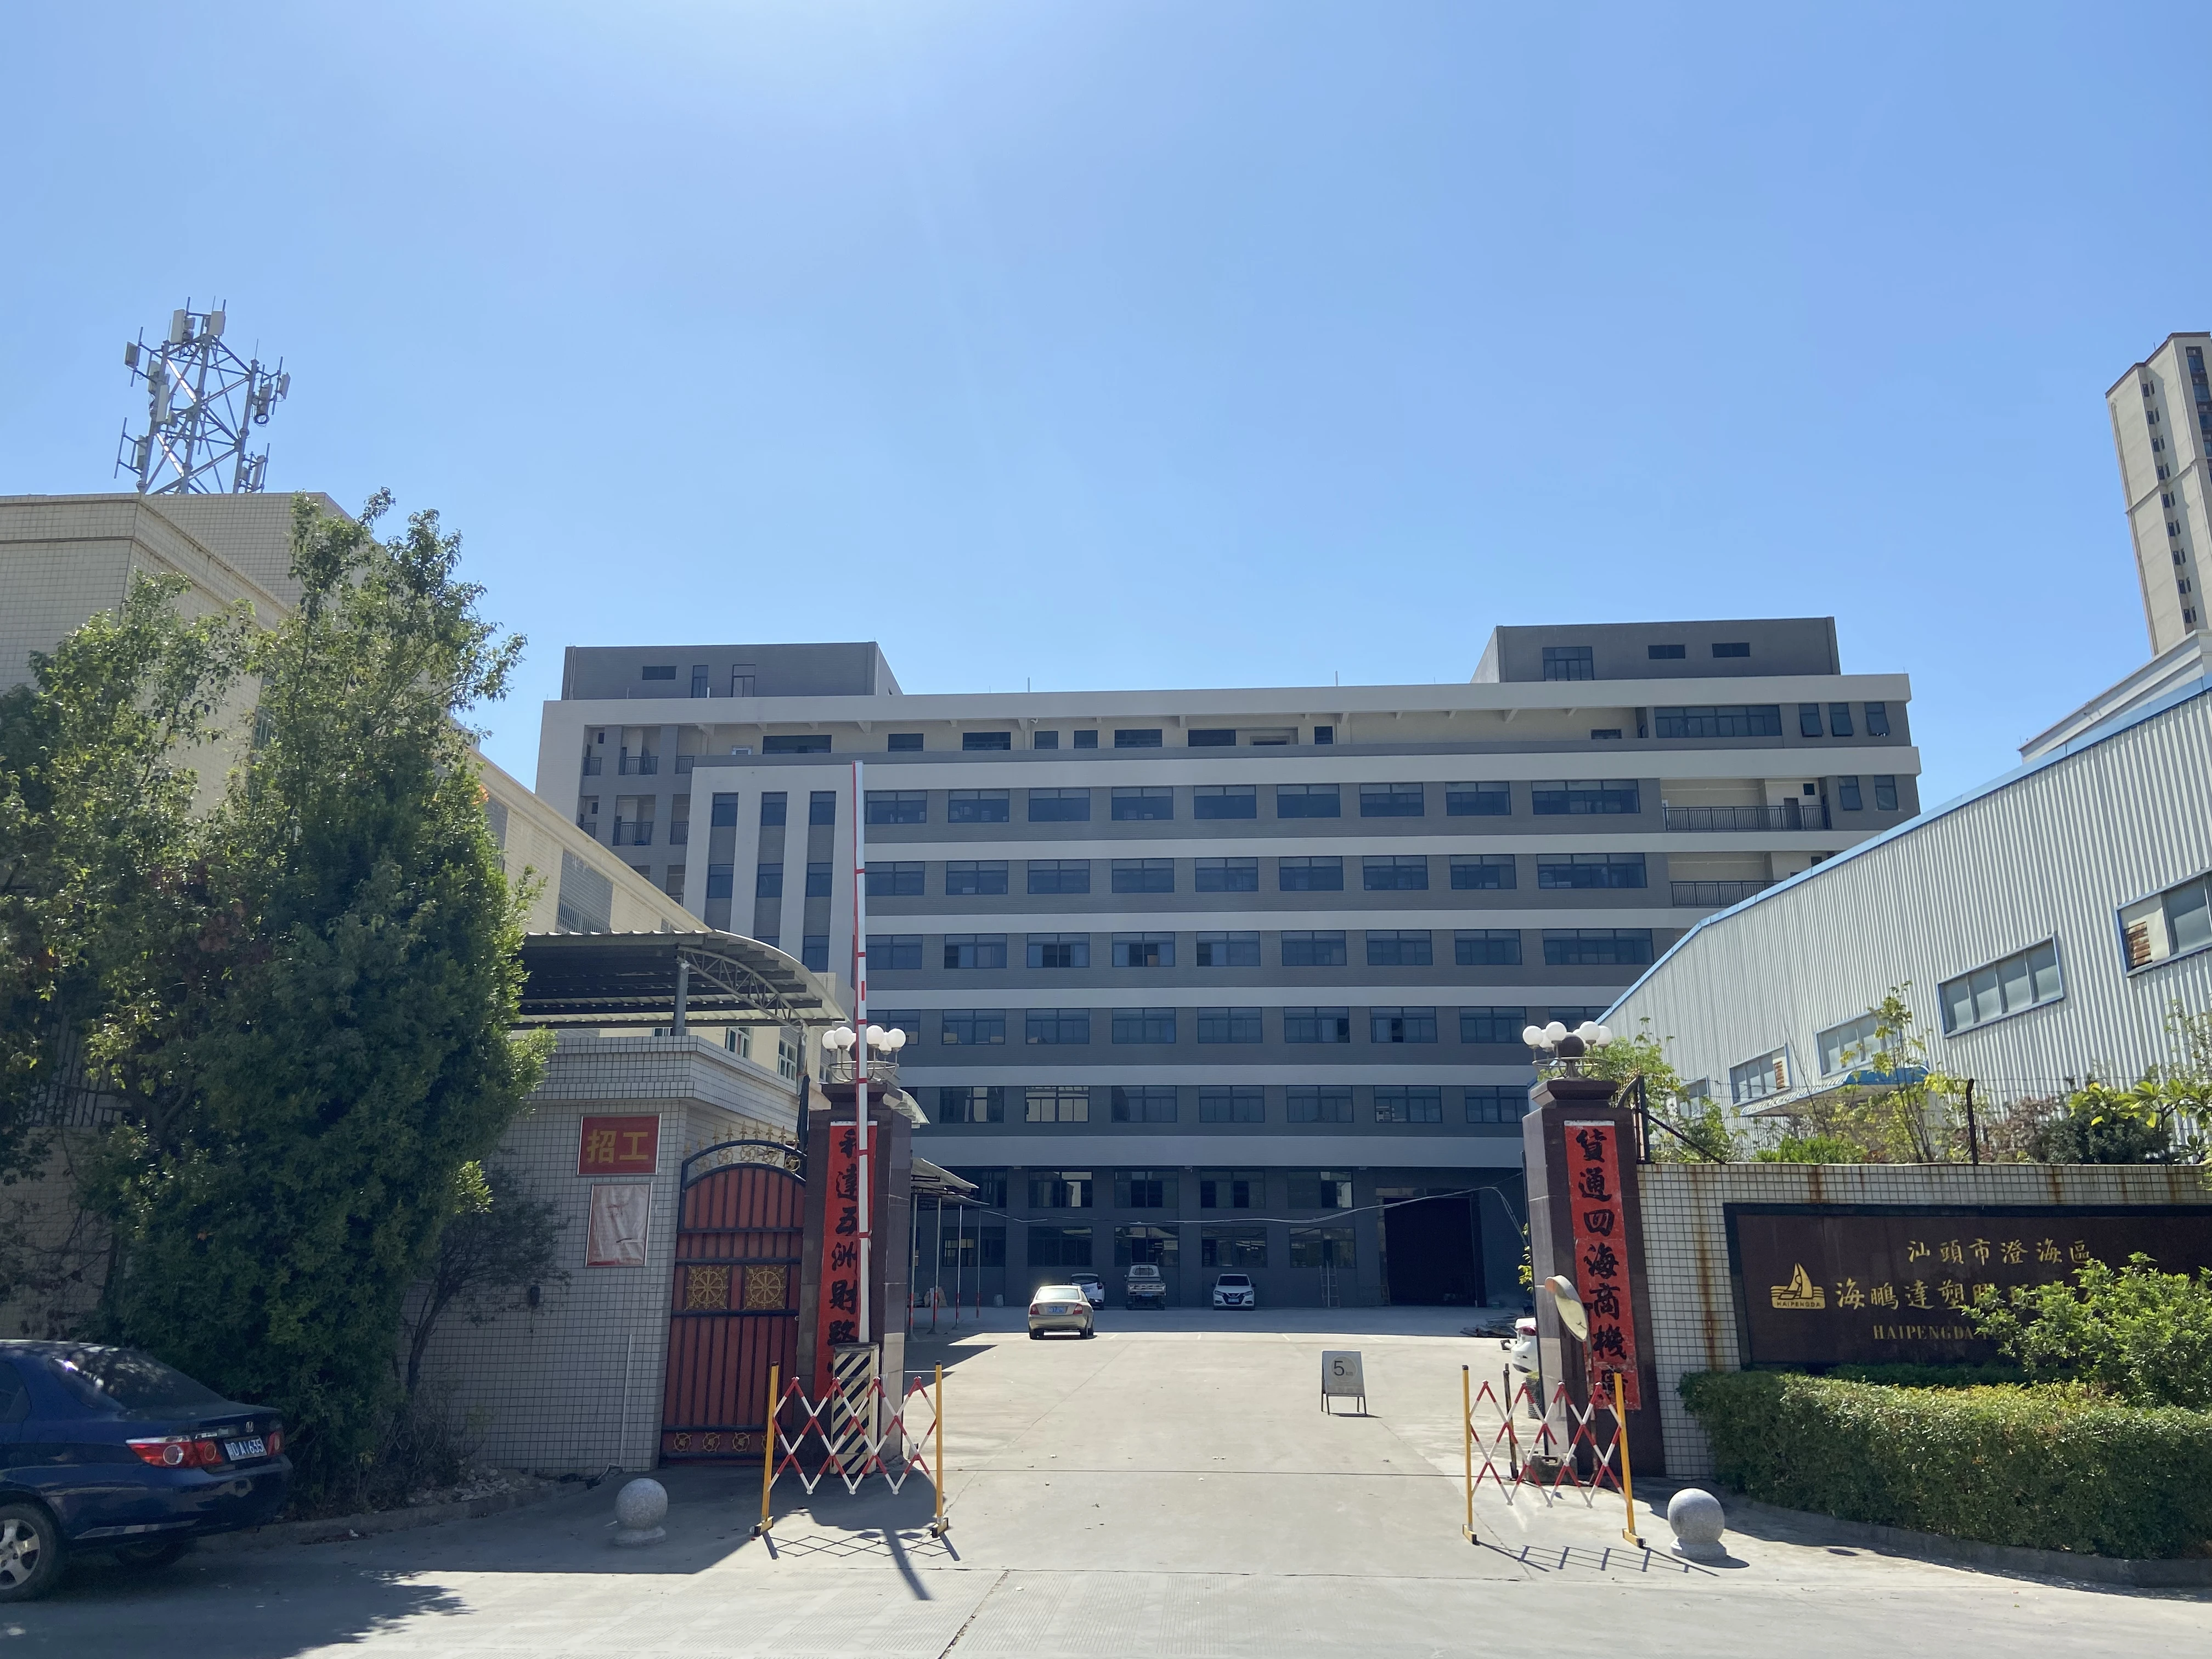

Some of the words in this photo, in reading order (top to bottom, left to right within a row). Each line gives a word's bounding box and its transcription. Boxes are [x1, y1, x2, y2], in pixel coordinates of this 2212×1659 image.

[586, 1129, 648, 1164] 招工
[1906, 1238, 2090, 1266] 汕頭市澄海區
[1872, 1324, 1975, 1340] HAIPENGDA
[1334, 1361, 1345, 1376] 5
